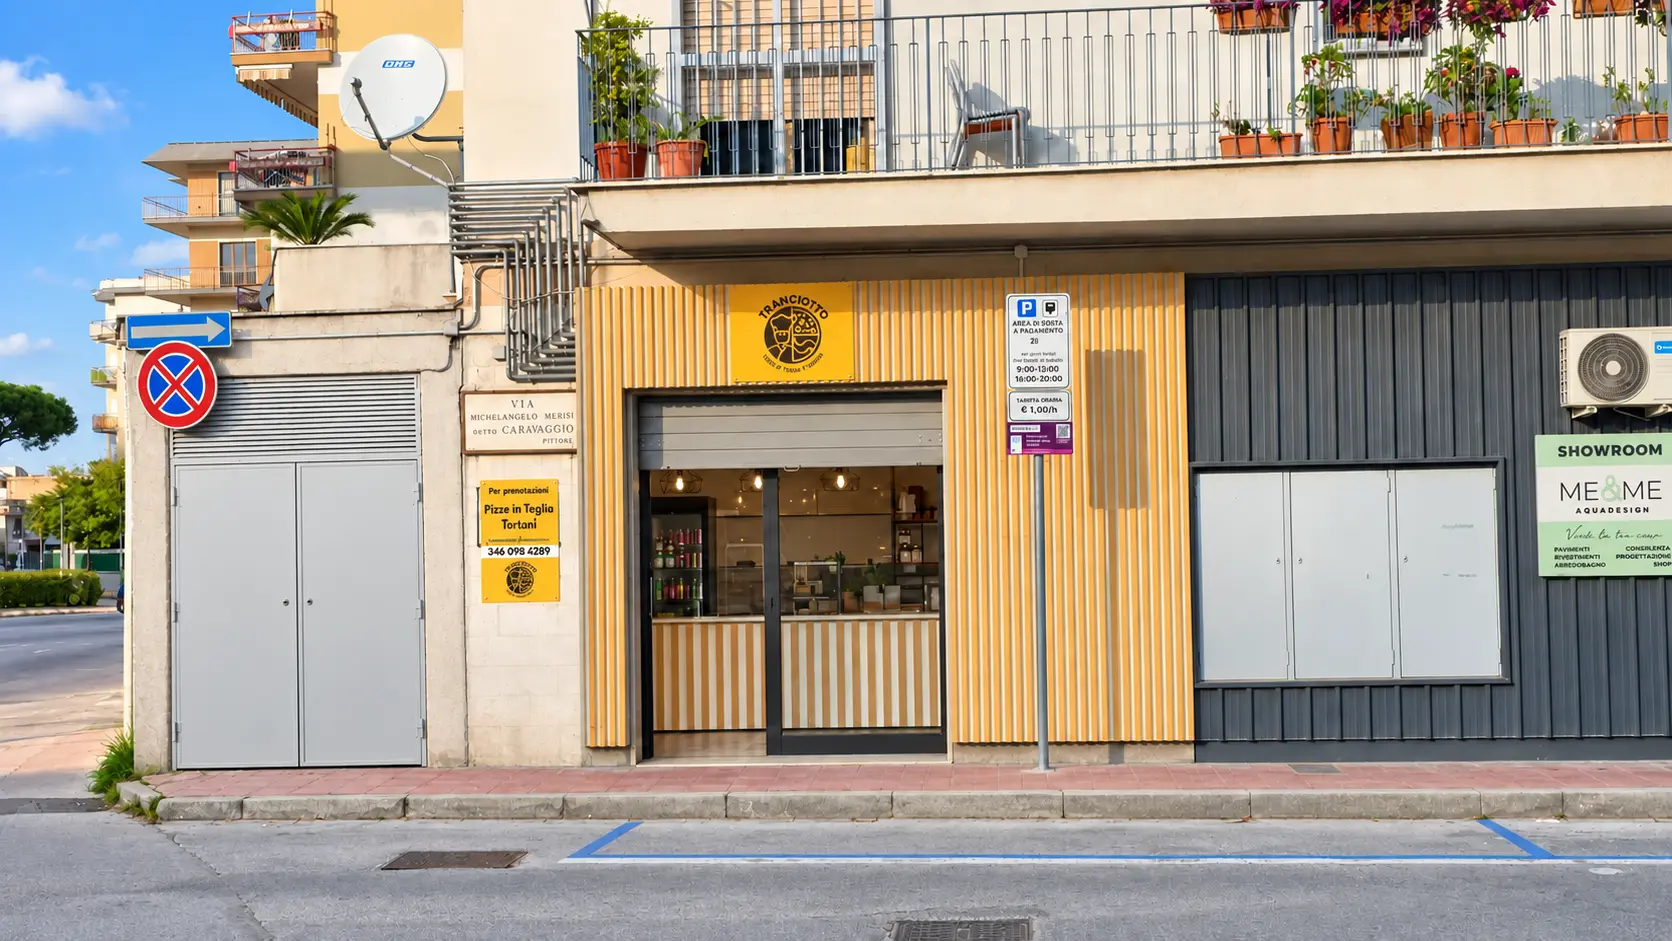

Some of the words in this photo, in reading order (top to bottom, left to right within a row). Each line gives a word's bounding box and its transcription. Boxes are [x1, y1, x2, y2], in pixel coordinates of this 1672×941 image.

[759, 294, 829, 320] TRANCIOTTO
[1022, 301, 1033, 315] P
[511, 399, 534, 408] VIA
[1021, 405, 1028, 413] €
[1030, 405, 1058, 414] 1,00/h
[470, 413, 538, 421] MICHELANGELO
[544, 412, 574, 420] MERISI
[502, 424, 574, 434] CARAVAGGIO
[1557, 443, 1663, 457] SHOWROOM
[488, 487, 500, 495] Per
[503, 486, 549, 496] prenotazioni
[1560, 474, 1662, 502] ME&ME
[484, 503, 510, 514] Pizze
[512, 503, 522, 514] in
[523, 503, 554, 516] Teglia
[1575, 506, 1650, 514] AQUADESIGN
[501, 518, 537, 529] Tortani
[487, 547, 505, 556] 346
[507, 546, 525, 556] 098
[527, 546, 551, 556] 4289
